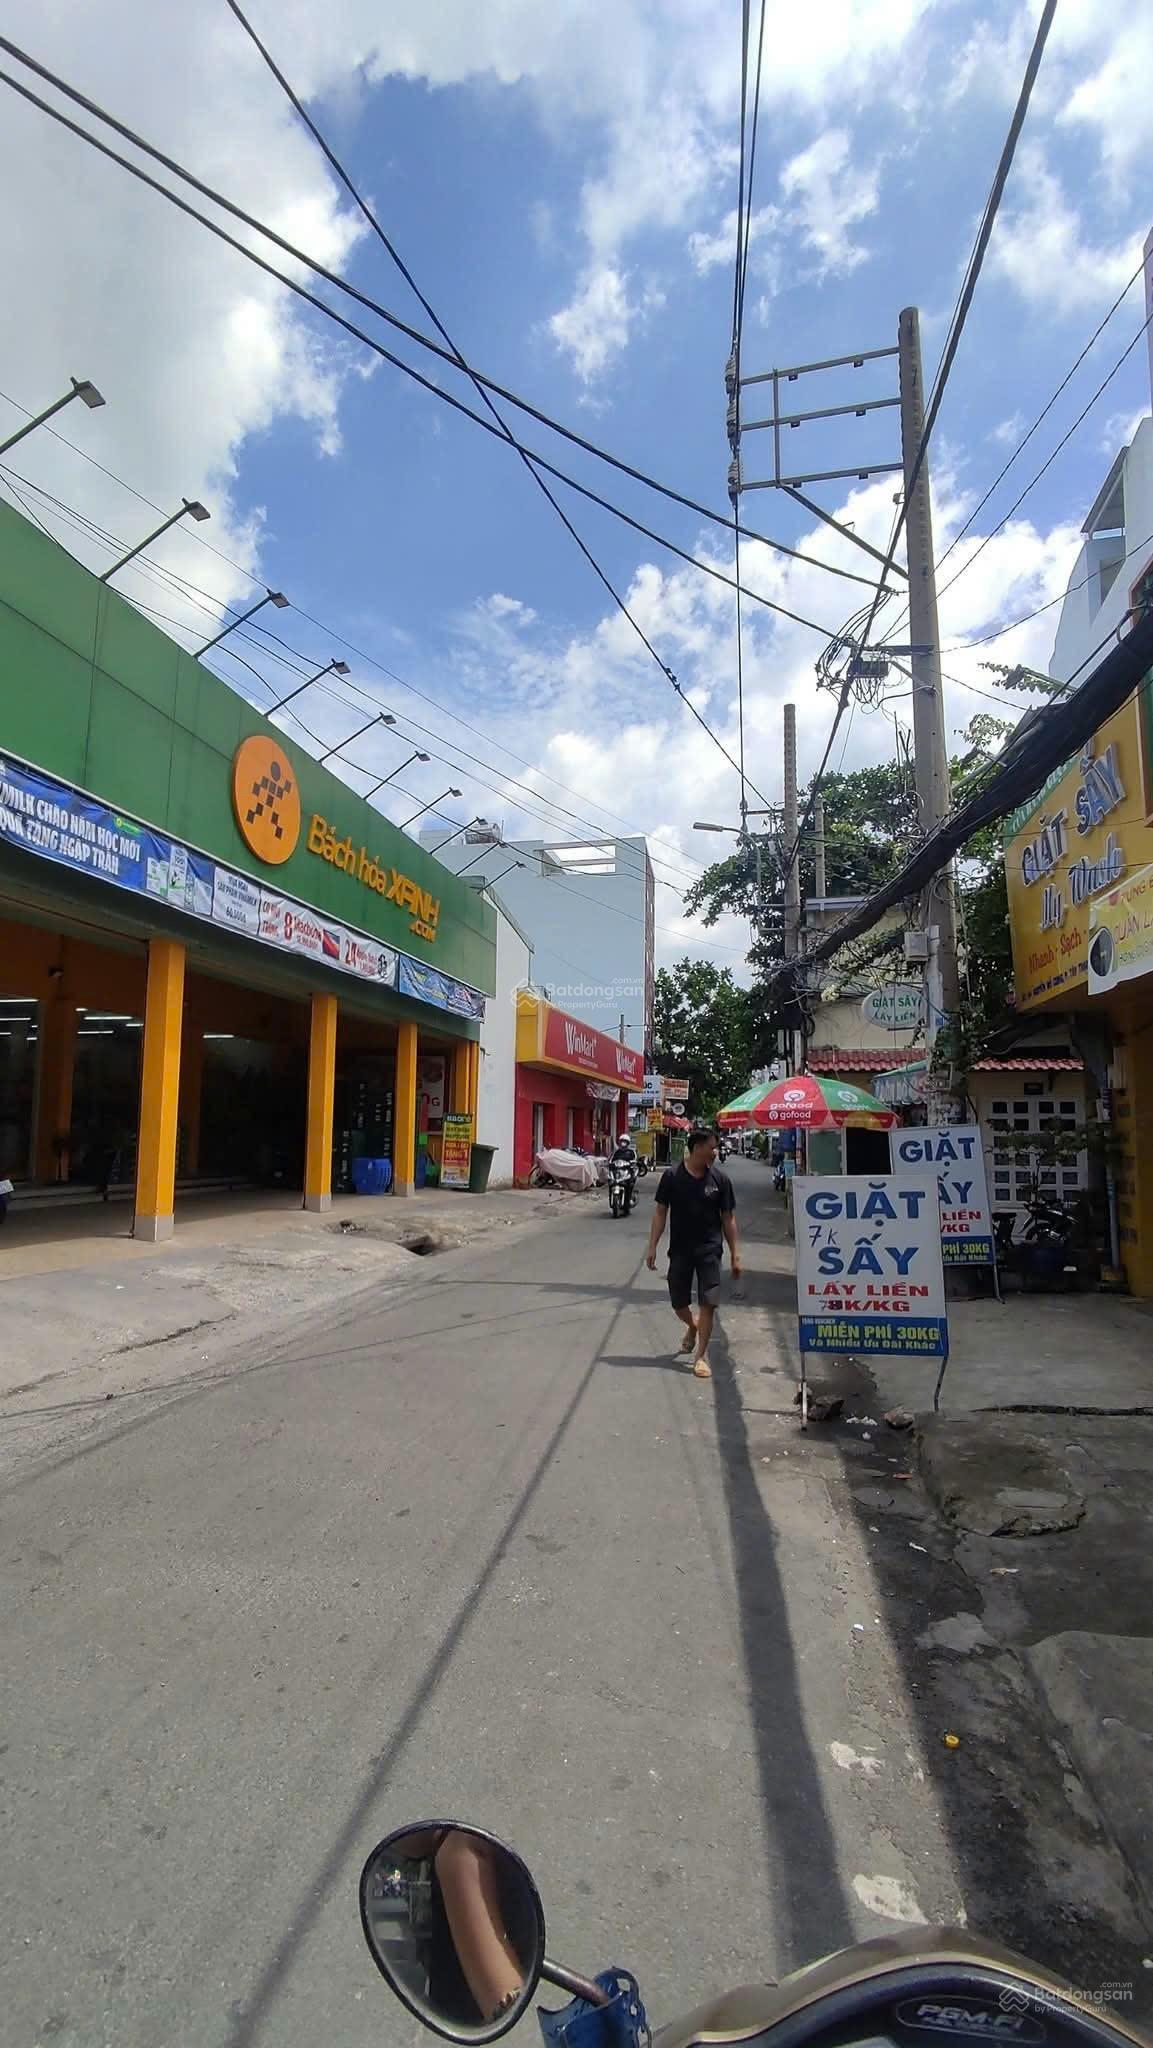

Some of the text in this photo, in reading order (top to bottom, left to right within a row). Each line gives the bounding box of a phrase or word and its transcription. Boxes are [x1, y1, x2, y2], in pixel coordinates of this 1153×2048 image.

[386, 867, 441, 927] XANH
[780, 1110, 811, 1120] gofood
[899, 1131, 976, 1167] GIẶT
[805, 1182, 926, 1227] GIẶT
[937, 1172, 974, 1205] ẤY
[817, 1233, 920, 1276] SẤY
[963, 1242, 990, 1254] 30KG
[864, 1323, 892, 1340] PHÍ
[896, 1326, 940, 1341] 30KG
